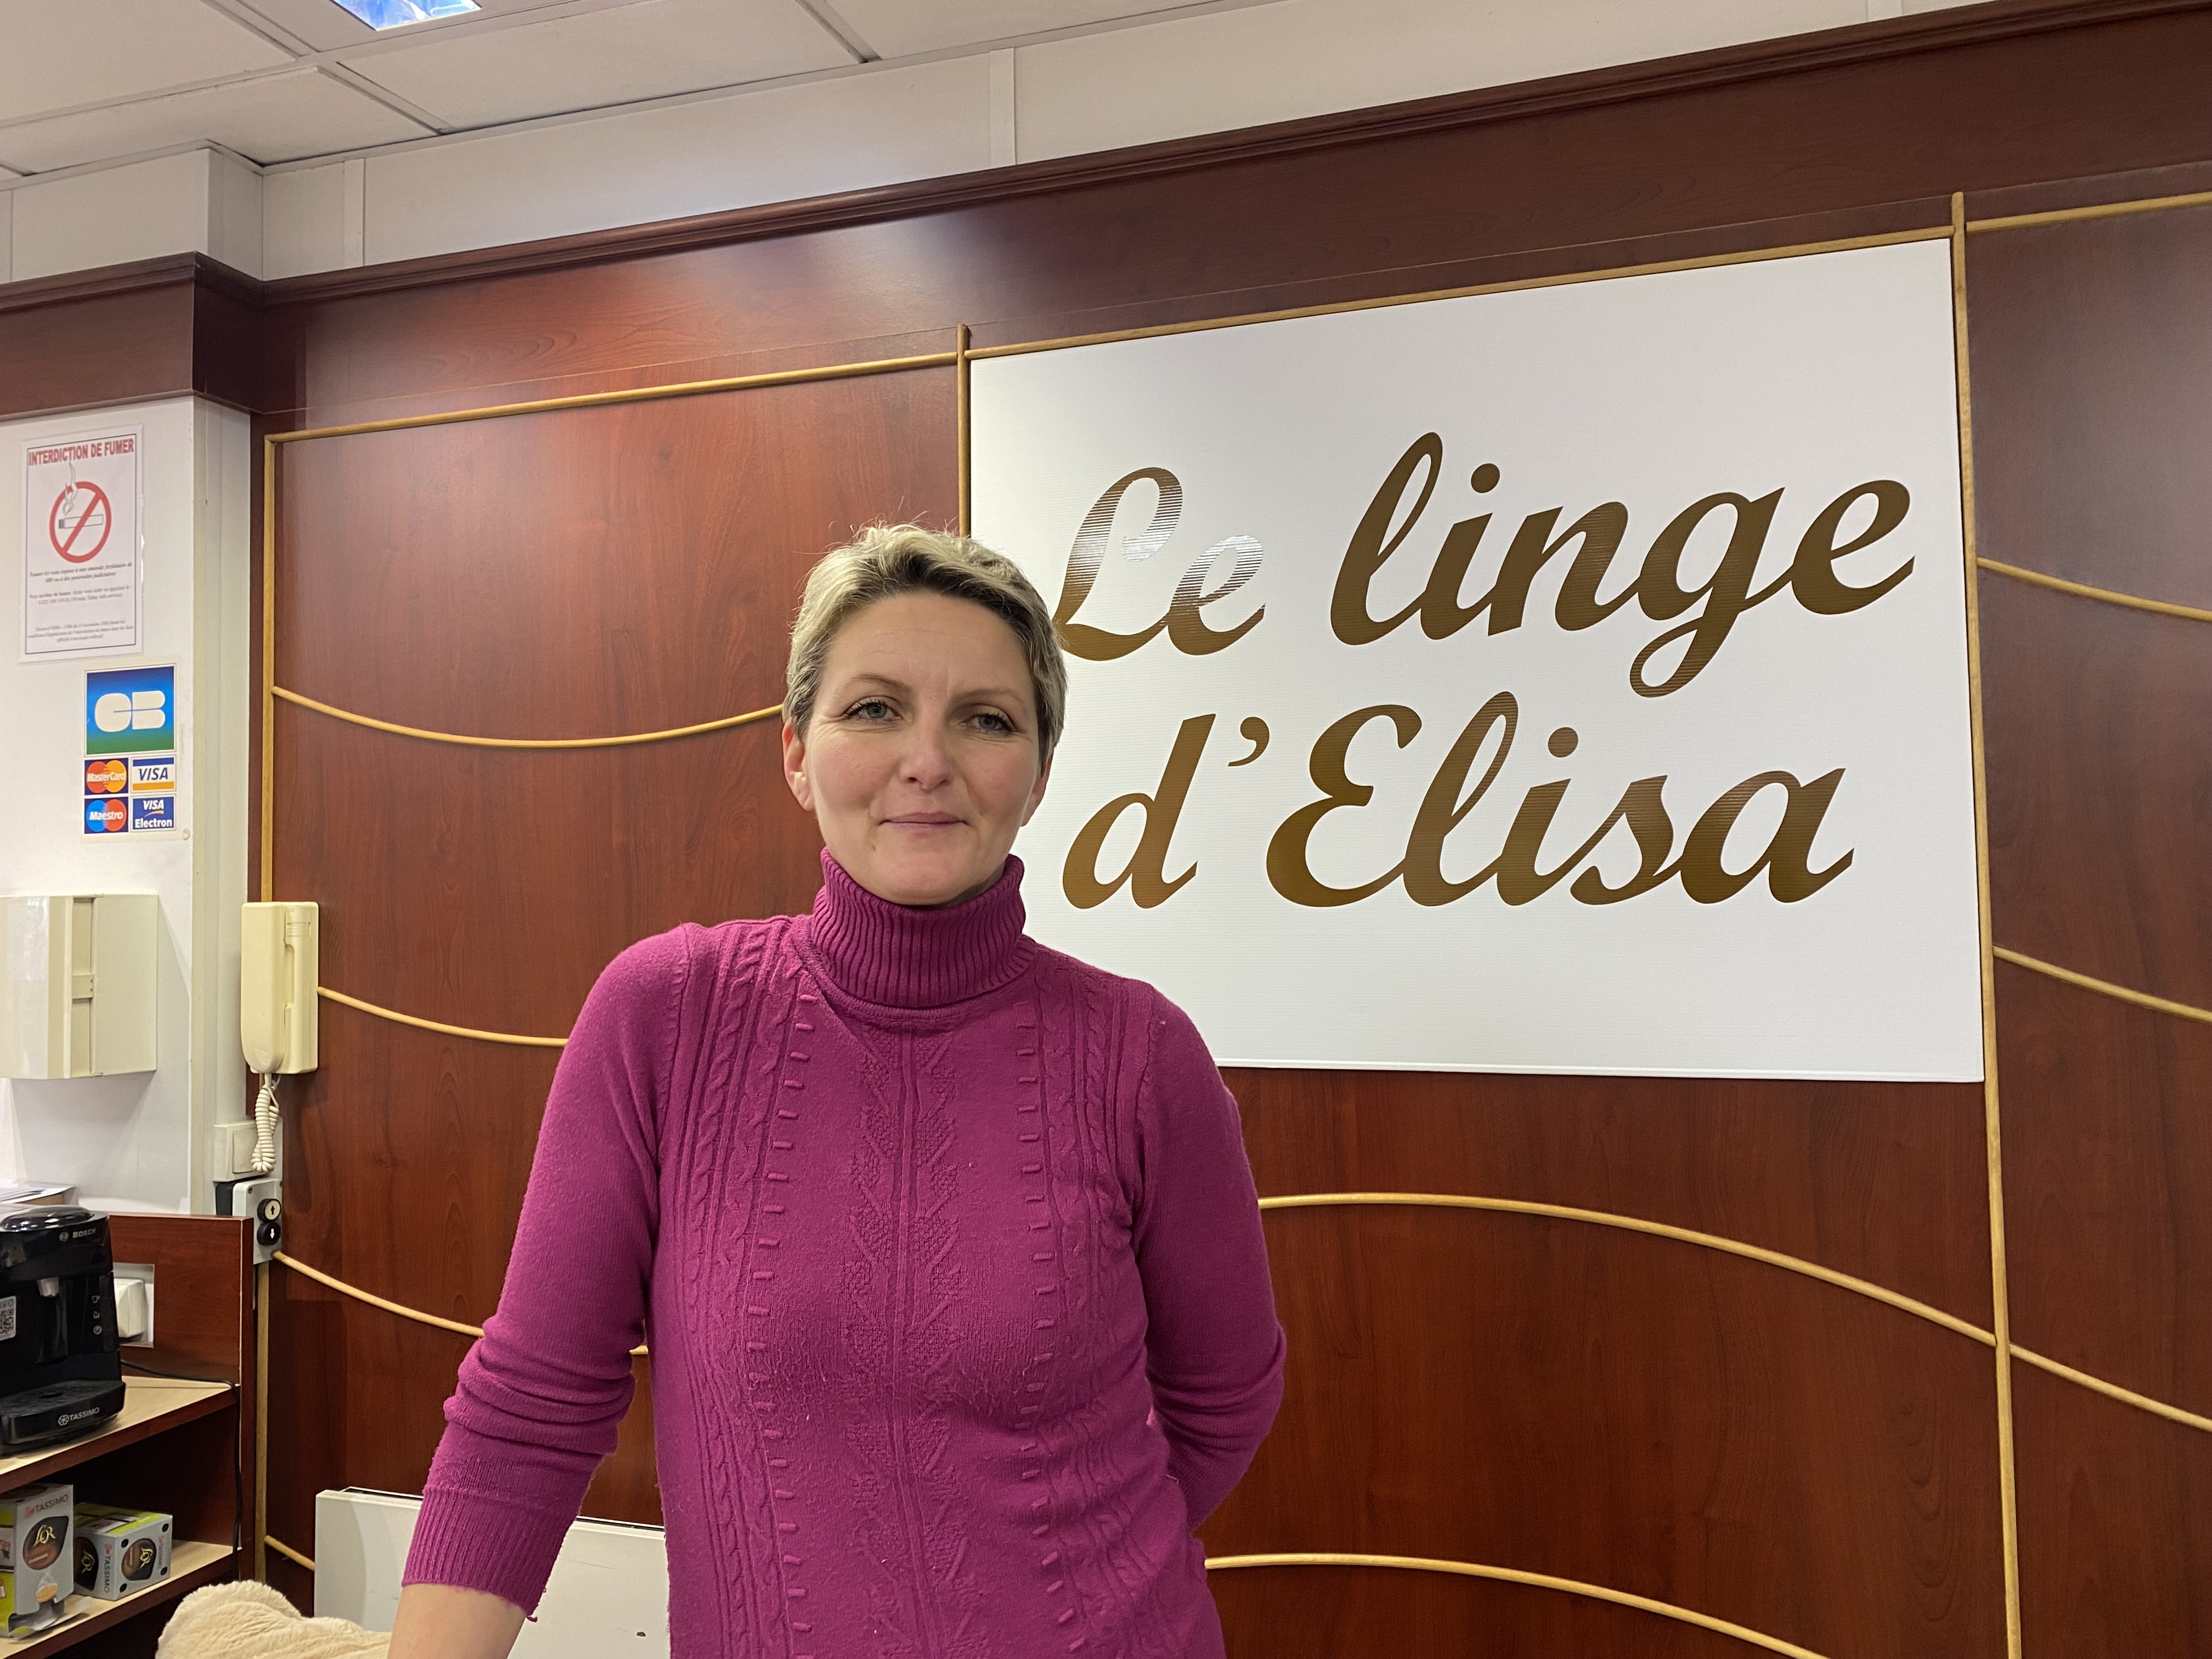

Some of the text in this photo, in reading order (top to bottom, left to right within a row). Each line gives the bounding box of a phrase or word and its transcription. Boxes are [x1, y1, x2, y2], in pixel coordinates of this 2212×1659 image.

[29, 438, 134, 465] INTERDICTION DE FUMER
[1051, 432, 1915, 698] Le linge
[95, 690, 165, 732] CB
[87, 771, 126, 782] MasterCard
[138, 767, 168, 781] VISA
[143, 799, 164, 810] VISA
[89, 810, 123, 821] Maestro
[135, 818, 172, 829] Electron
[72, 1228, 96, 1238] BOSCH
[69, 1407, 100, 1421] TASSIMO
[34, 1494, 69, 1512] TASSIMO
